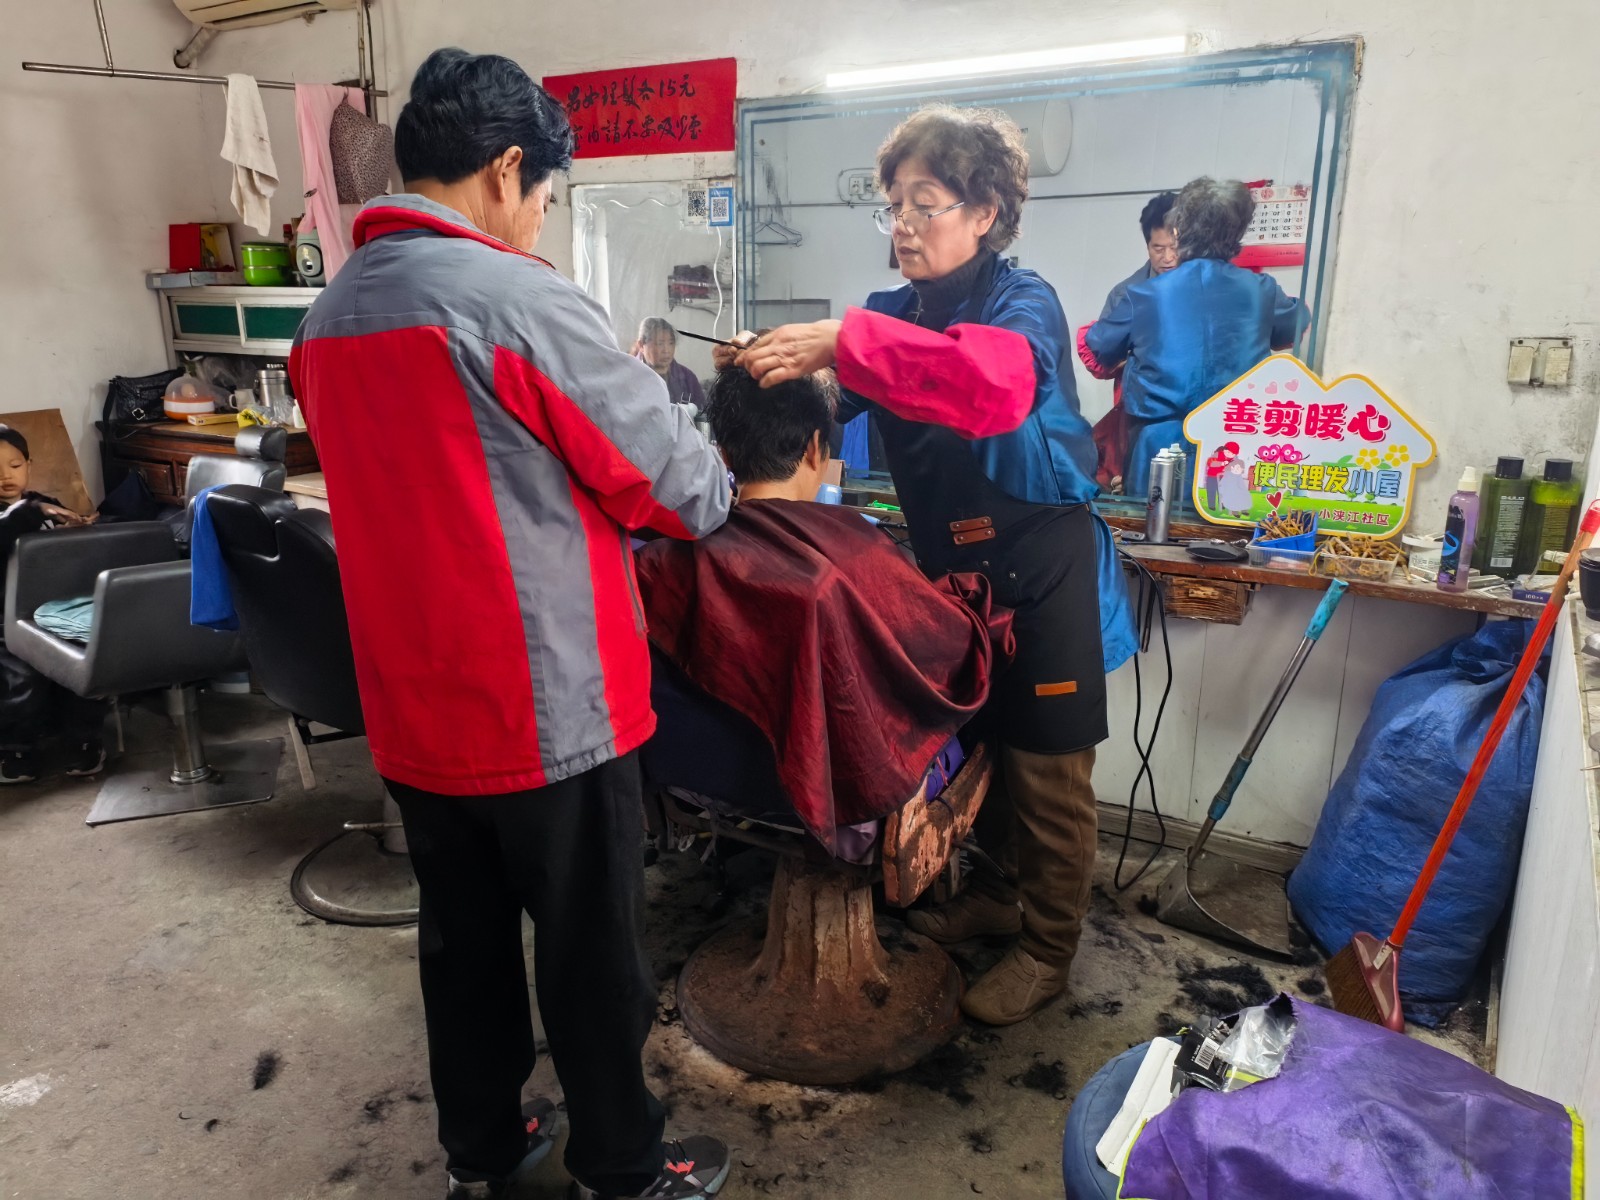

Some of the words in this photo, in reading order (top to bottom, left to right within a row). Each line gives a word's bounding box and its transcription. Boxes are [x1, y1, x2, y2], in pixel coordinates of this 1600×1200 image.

[1223, 397, 1391, 442] 善剪暖心
[1253, 461, 1402, 498] 便民理发小屋
